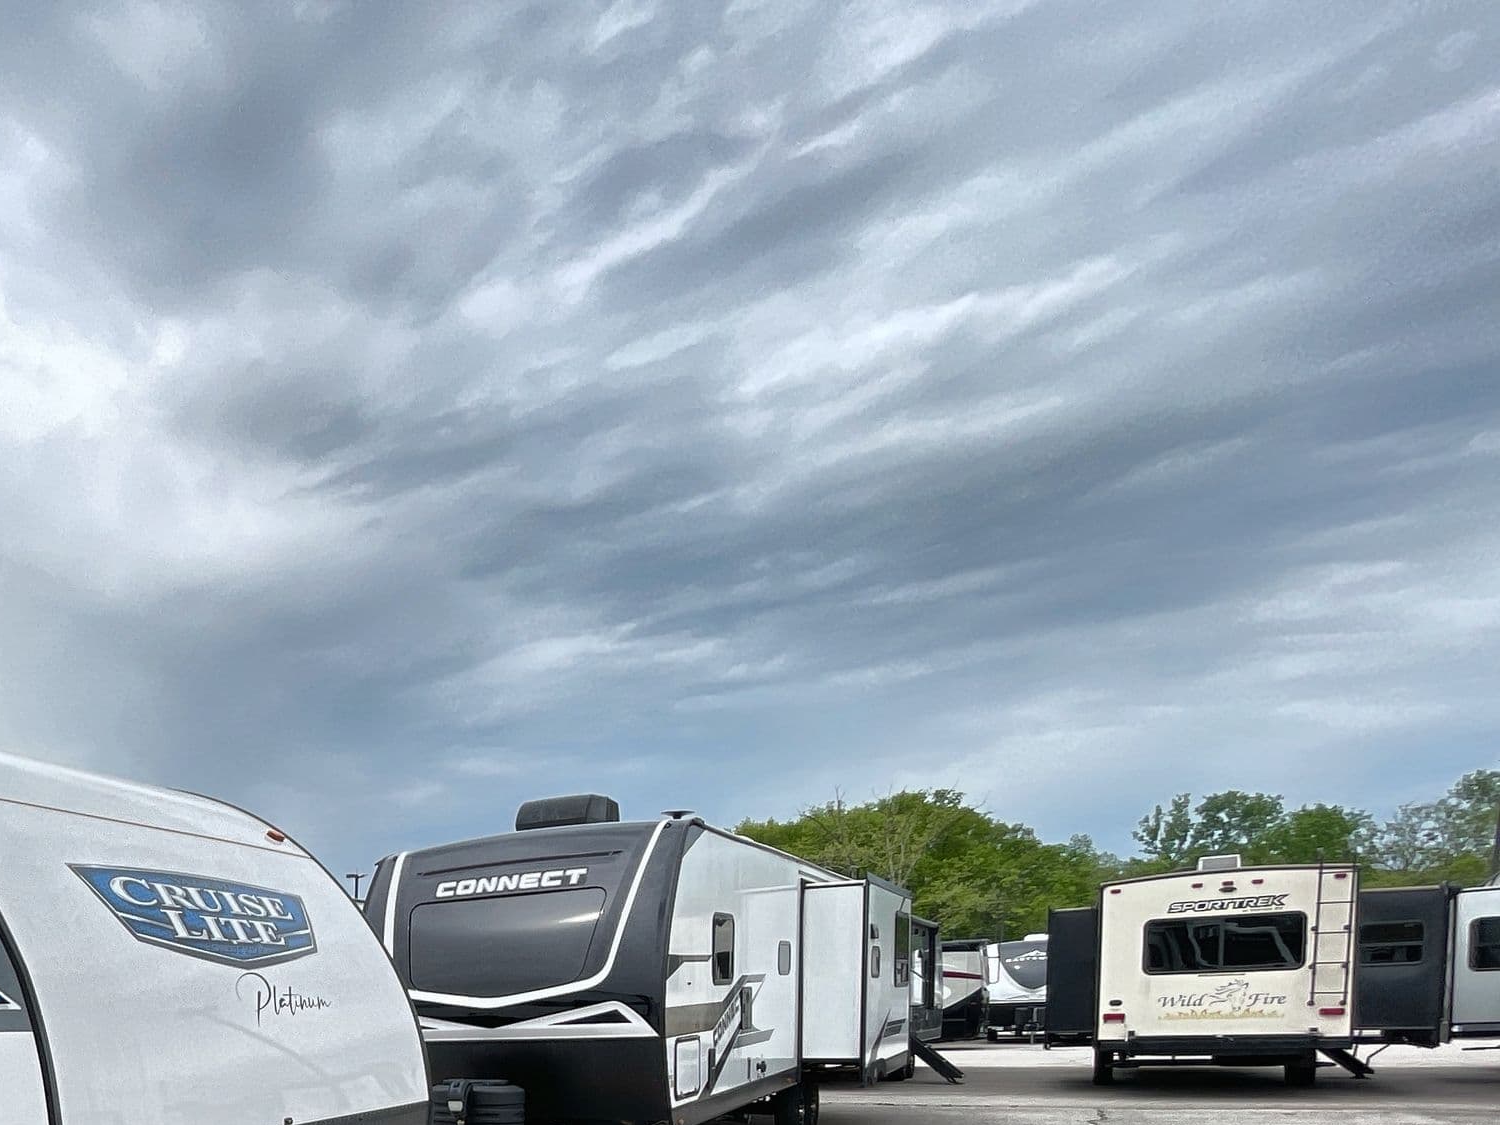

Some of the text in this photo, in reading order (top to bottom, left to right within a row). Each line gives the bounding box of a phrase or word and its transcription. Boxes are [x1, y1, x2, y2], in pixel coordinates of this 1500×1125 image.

[109, 876, 294, 921] CRUISE
[436, 868, 588, 898] CONNECT
[1167, 894, 1290, 914] SPORTTREK
[160, 909, 286, 946] LITE
[235, 972, 332, 1028] Platinum
[1157, 992, 1288, 1008] Wild Fire
